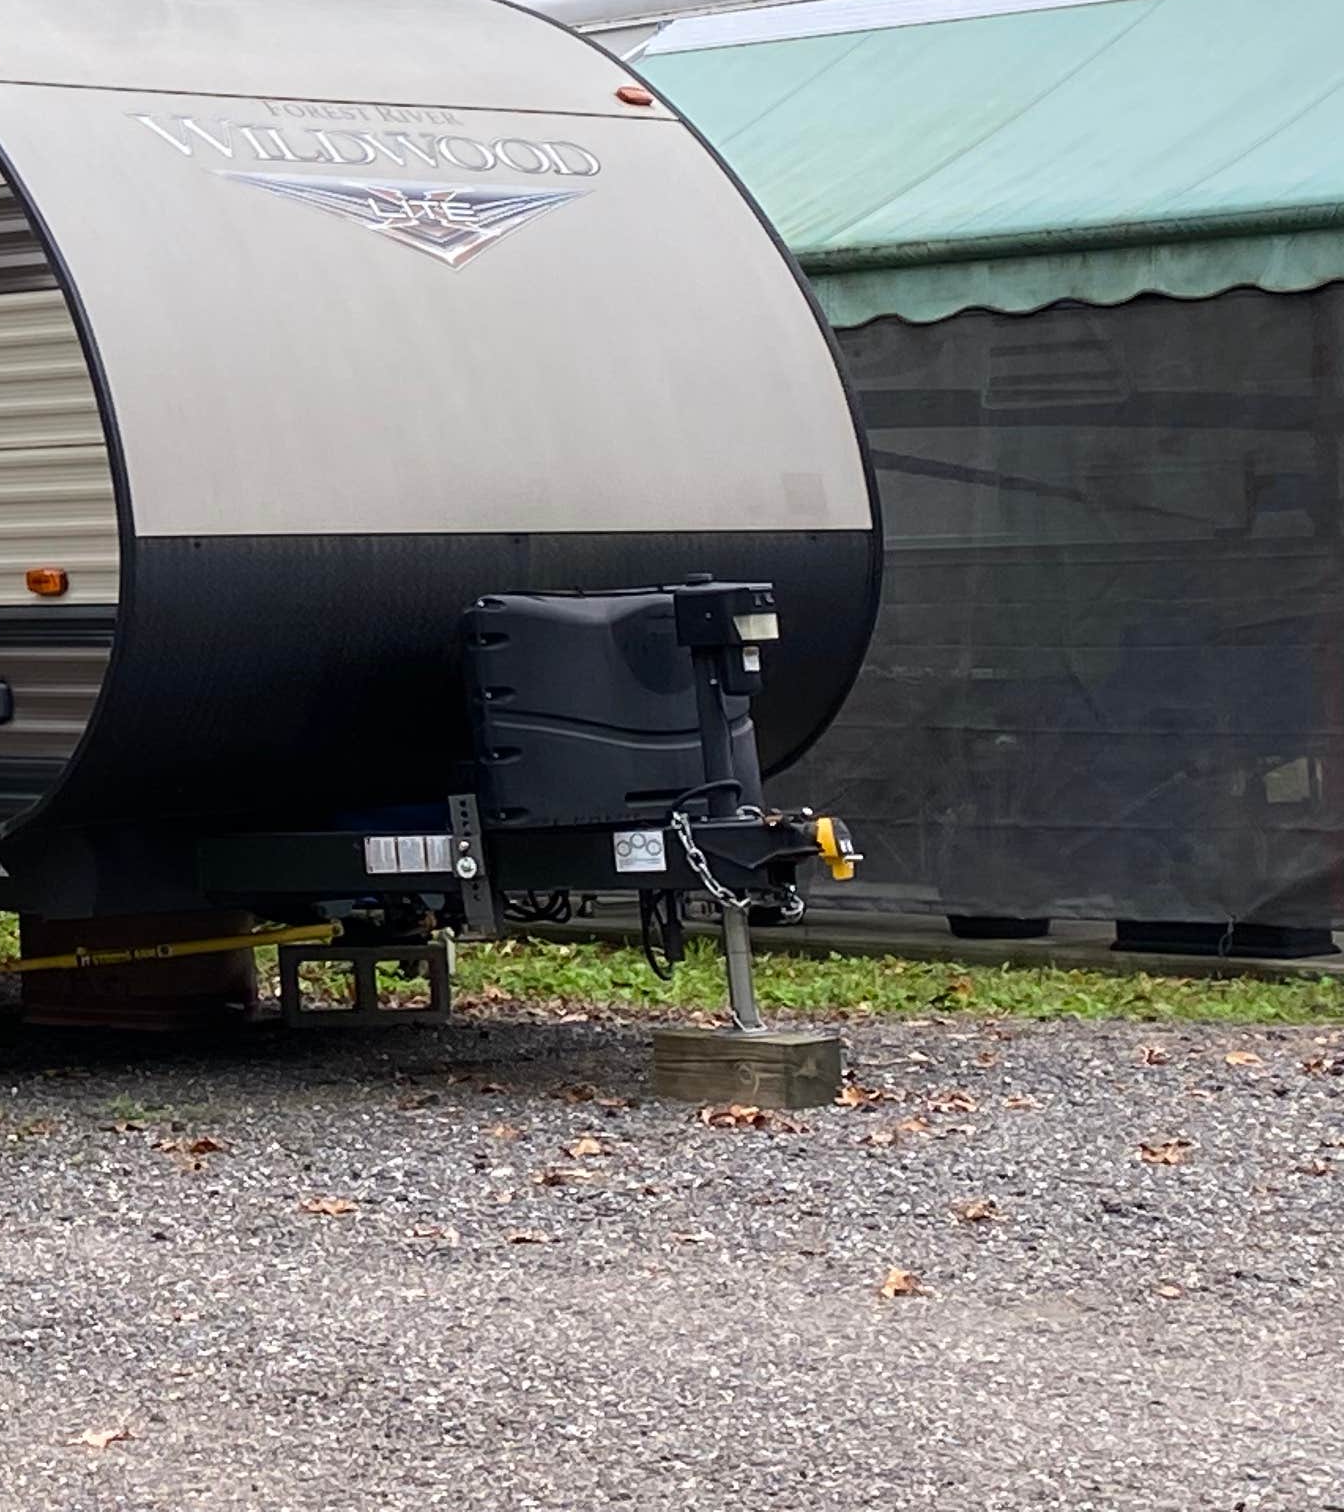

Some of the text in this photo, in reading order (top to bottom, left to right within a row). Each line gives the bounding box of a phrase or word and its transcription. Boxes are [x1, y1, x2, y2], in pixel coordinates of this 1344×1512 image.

[263, 100, 464, 126] FOREST RIVER
[124, 112, 601, 176] WILDWOOD
